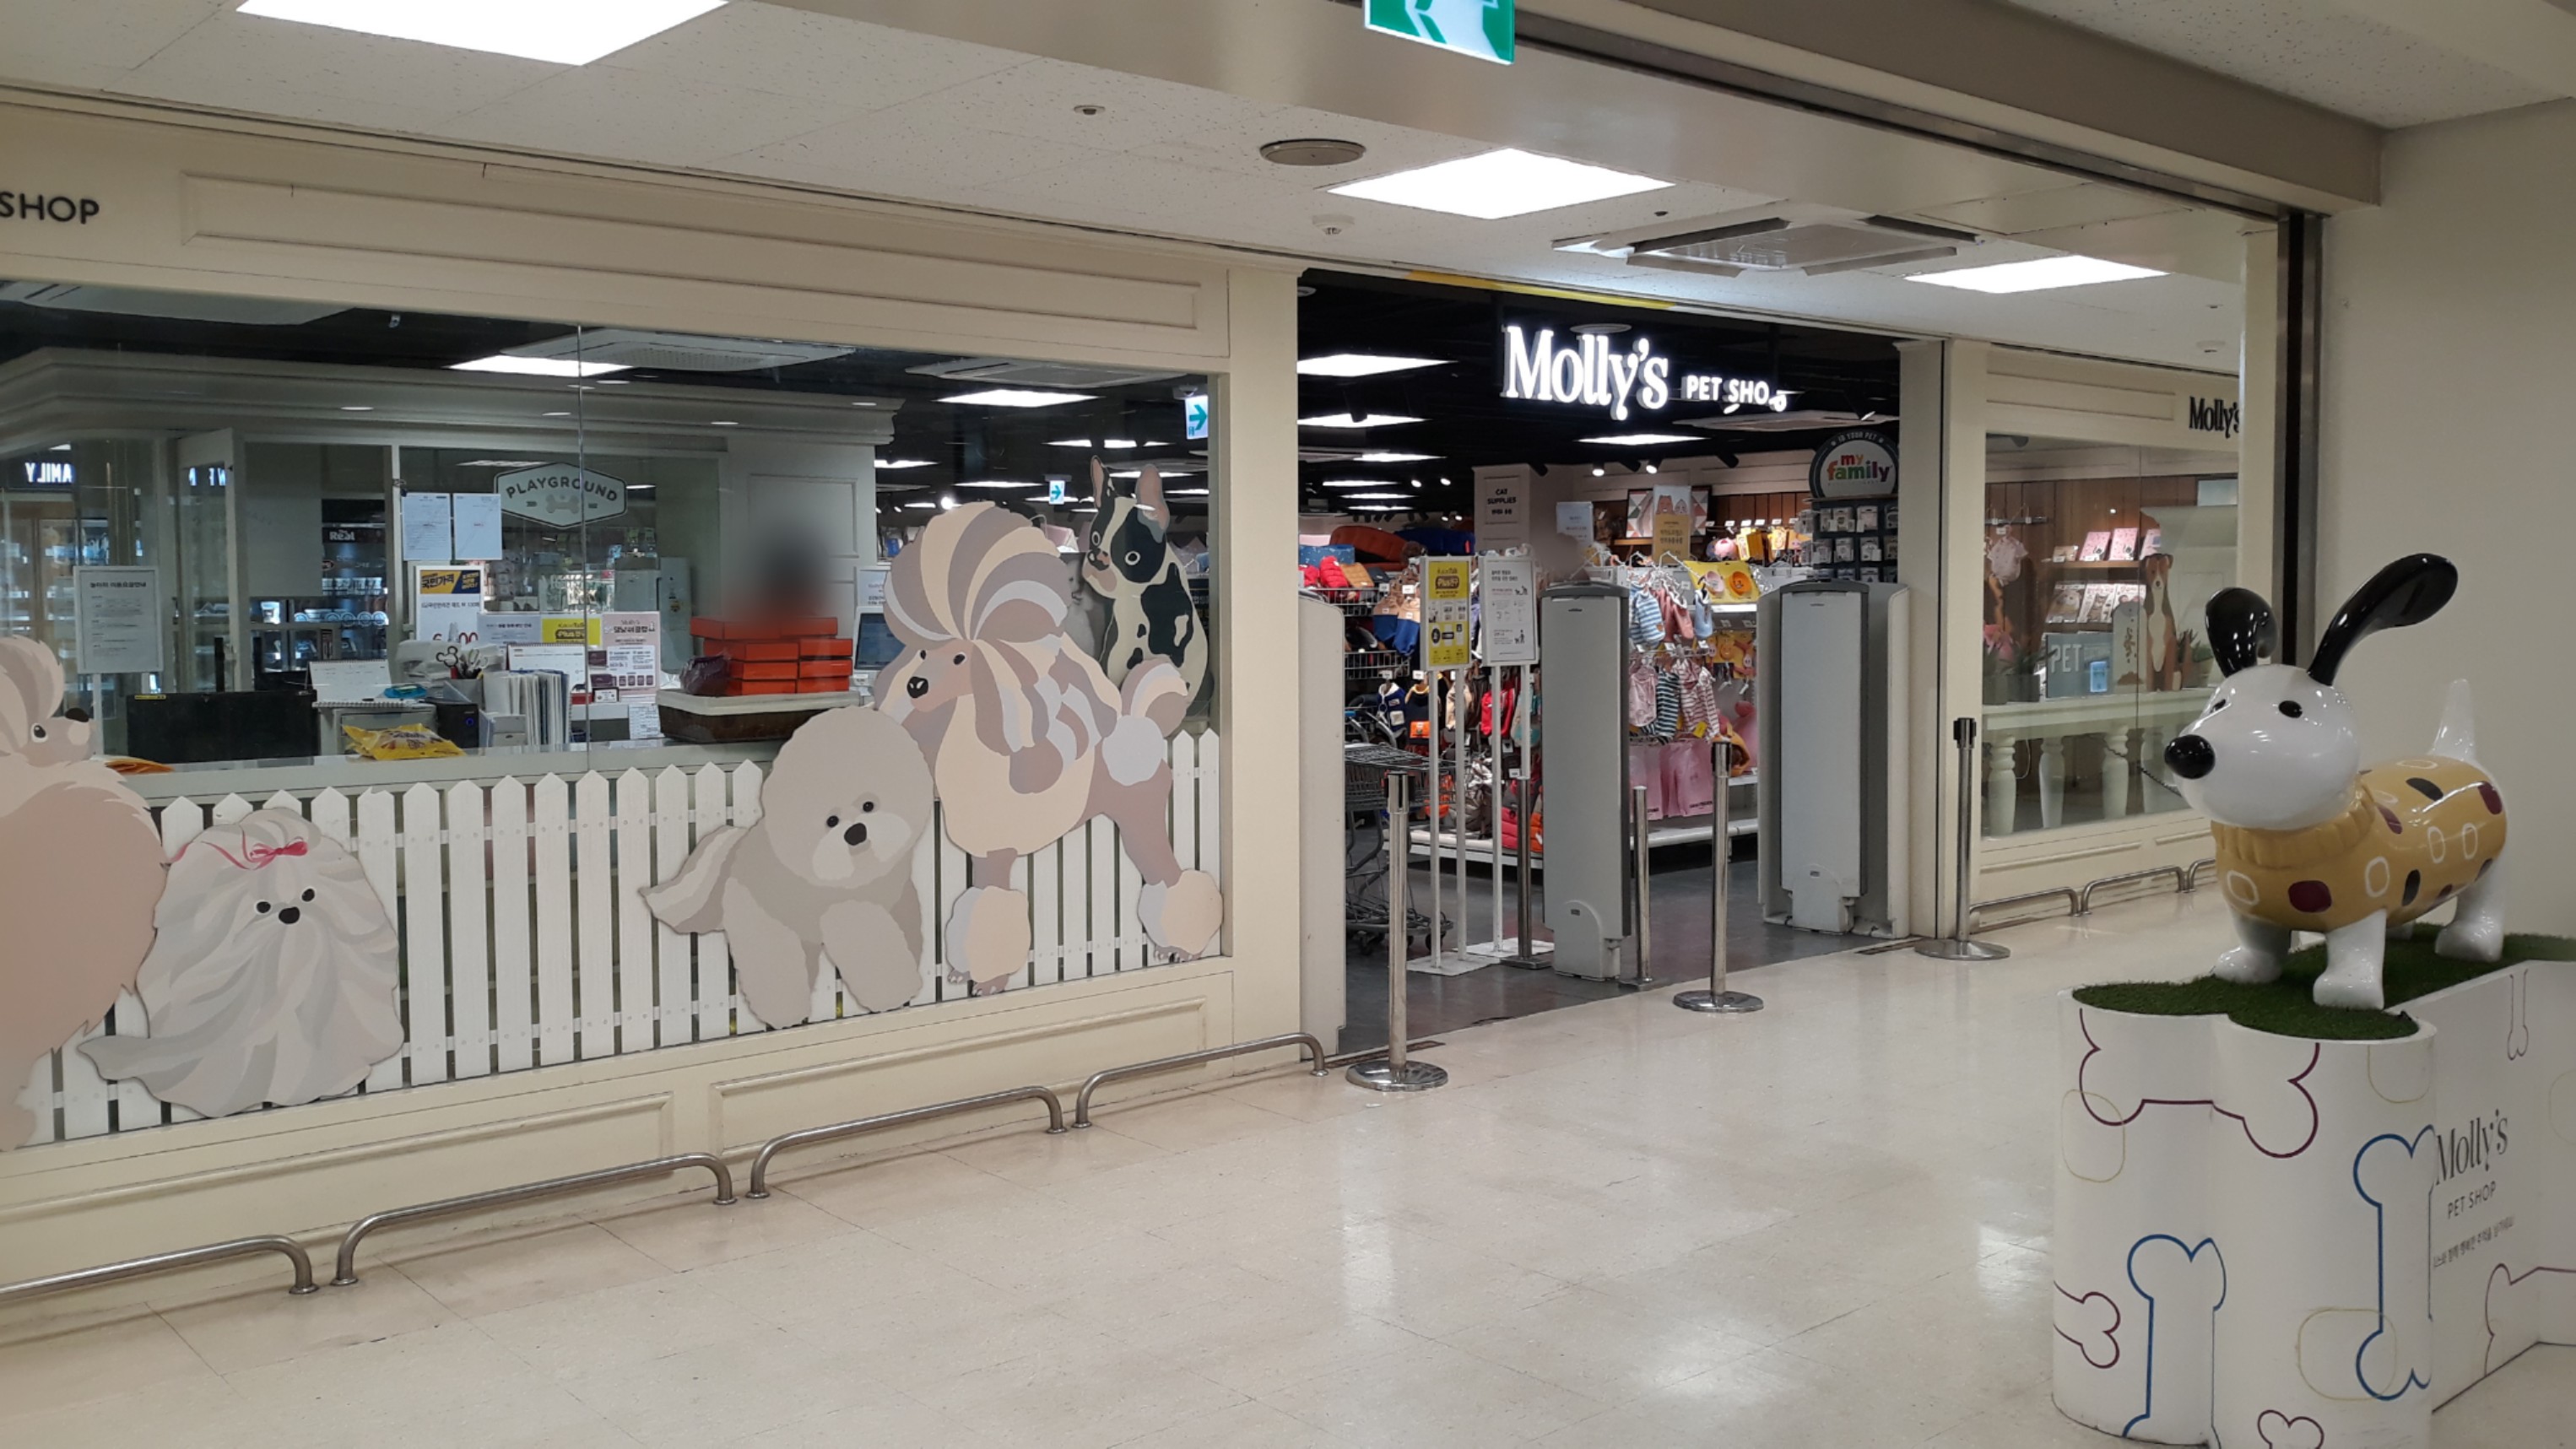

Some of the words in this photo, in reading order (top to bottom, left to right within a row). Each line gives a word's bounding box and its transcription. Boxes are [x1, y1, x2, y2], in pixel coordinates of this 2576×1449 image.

[0, 192, 100, 224] SHOP
[1500, 325, 1669, 421] Molly's
[1682, 375, 1723, 401] PET
[1826, 460, 1891, 482] family
[1841, 453, 1864, 466] my
[506, 476, 618, 502] PLAYGROUND
[1487, 496, 1517, 505] SUPPLIES
[2436, 1108, 2508, 1186] Molly's
[2447, 1196, 2465, 1219] PET
[2468, 1181, 2497, 1208] SHOP
